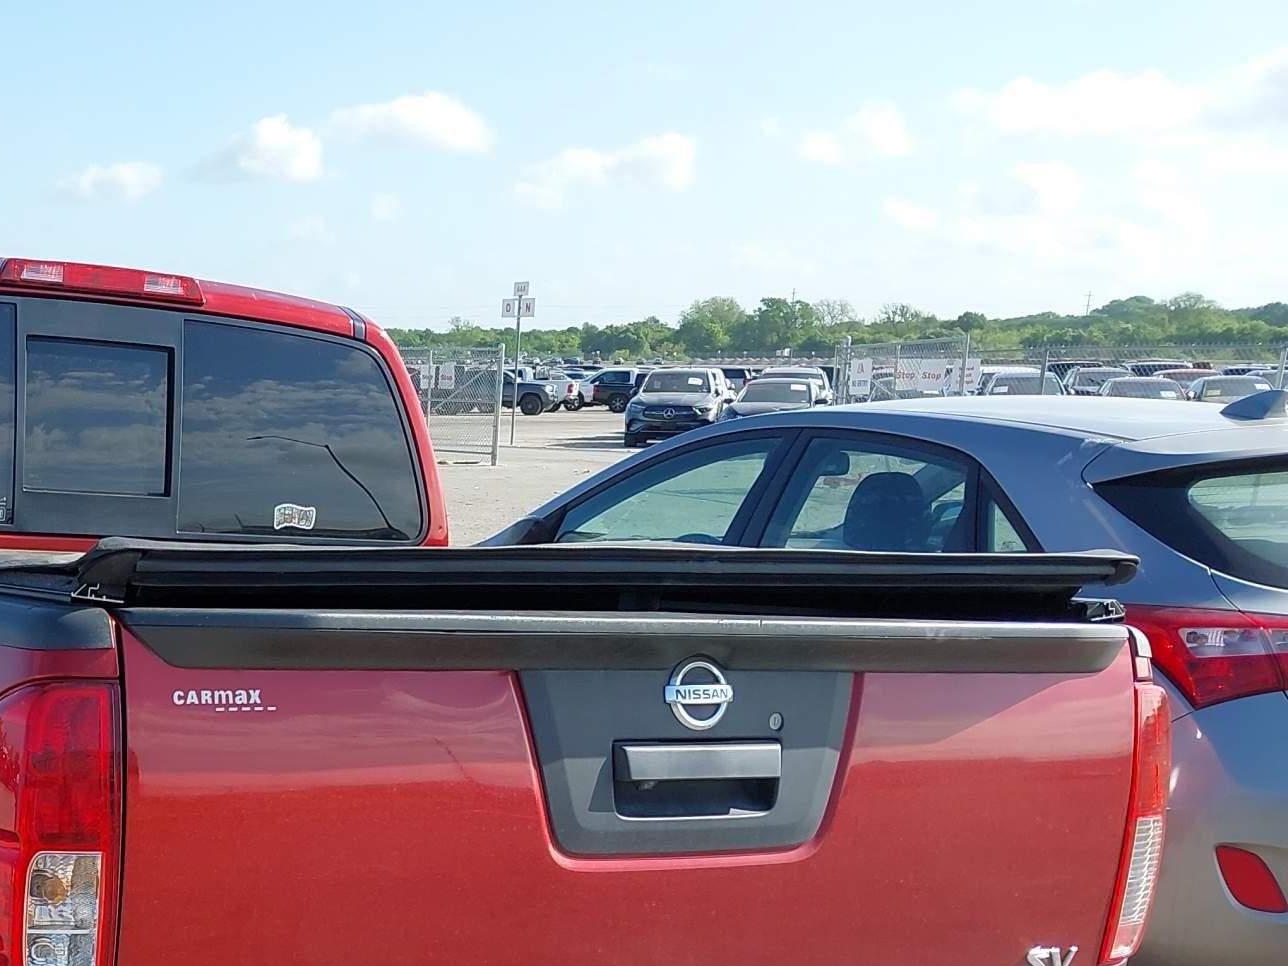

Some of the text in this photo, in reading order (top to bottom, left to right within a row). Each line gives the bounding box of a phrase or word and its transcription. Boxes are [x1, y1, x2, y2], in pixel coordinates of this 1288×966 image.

[525, 302, 531, 313] N
[921, 371, 942, 381] Stop
[675, 688, 728, 700] NISSAN
